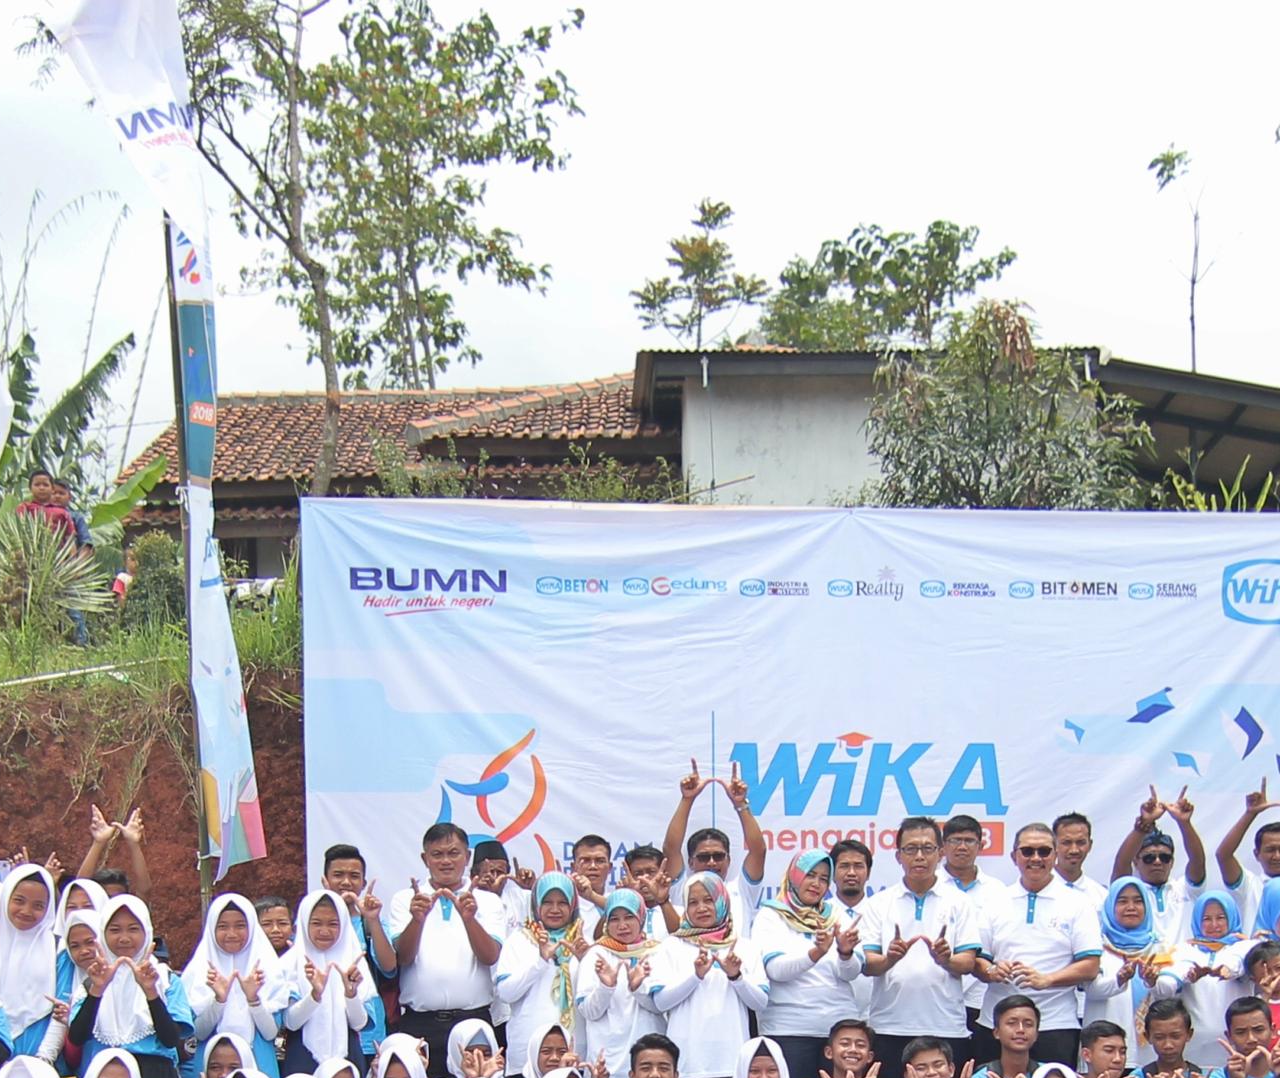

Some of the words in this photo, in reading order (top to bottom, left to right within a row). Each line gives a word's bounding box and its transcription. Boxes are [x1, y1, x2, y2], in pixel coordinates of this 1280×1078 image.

[349, 567, 507, 593] BUMN
[564, 578, 609, 593] BETON
[651, 576, 728, 596] Gedung
[952, 582, 989, 590] REKAYASA
[1156, 583, 1197, 592] SERANG
[856, 580, 904, 601] Realty
[363, 594, 400, 608] Hadir
[406, 594, 446, 608] untuk
[451, 594, 496, 610] negeri
